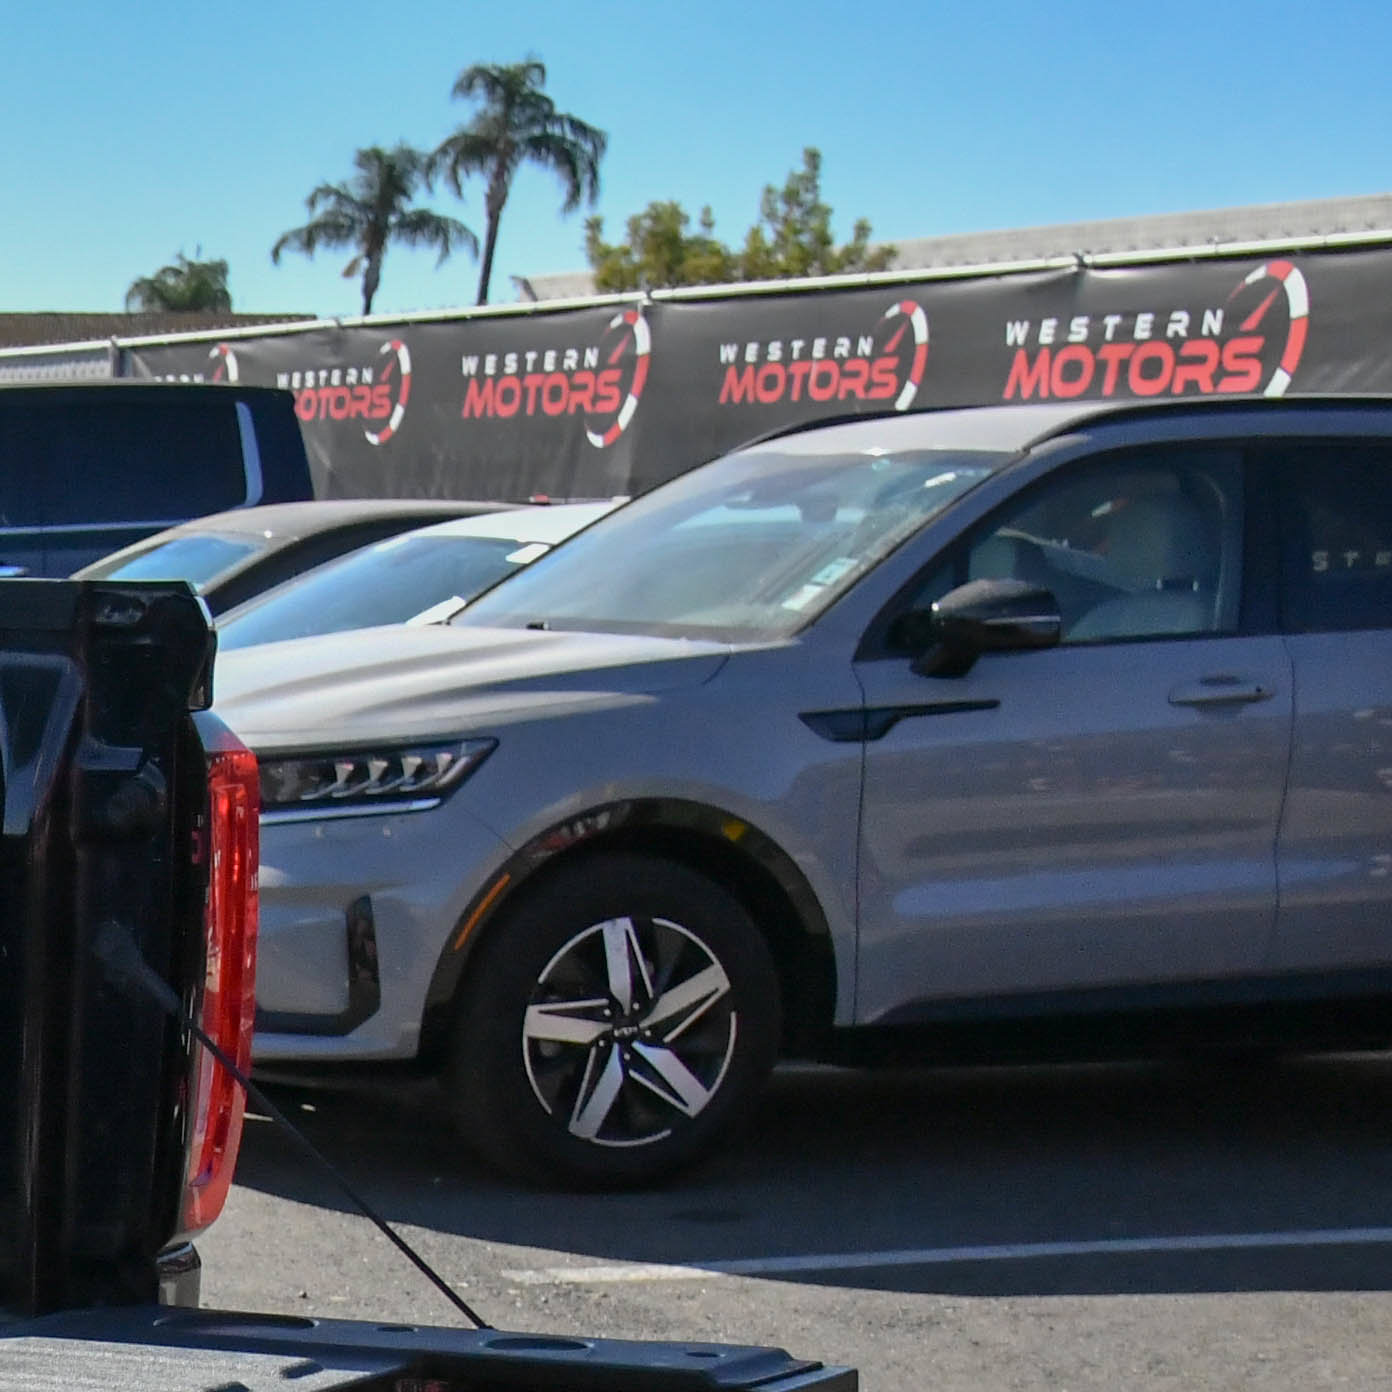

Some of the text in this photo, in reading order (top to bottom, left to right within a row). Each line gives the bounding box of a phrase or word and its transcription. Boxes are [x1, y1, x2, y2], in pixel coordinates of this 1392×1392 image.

[1006, 308, 1224, 346] WESTERN
[462, 346, 600, 376] WESTERN
[719, 335, 874, 364] WESTERN
[1002, 335, 1265, 400] MOTORS
[276, 367, 373, 389] WESTERN
[461, 369, 623, 419] MOTORS
[719, 356, 900, 404] MOTORS
[293, 383, 392, 421] OTORS
